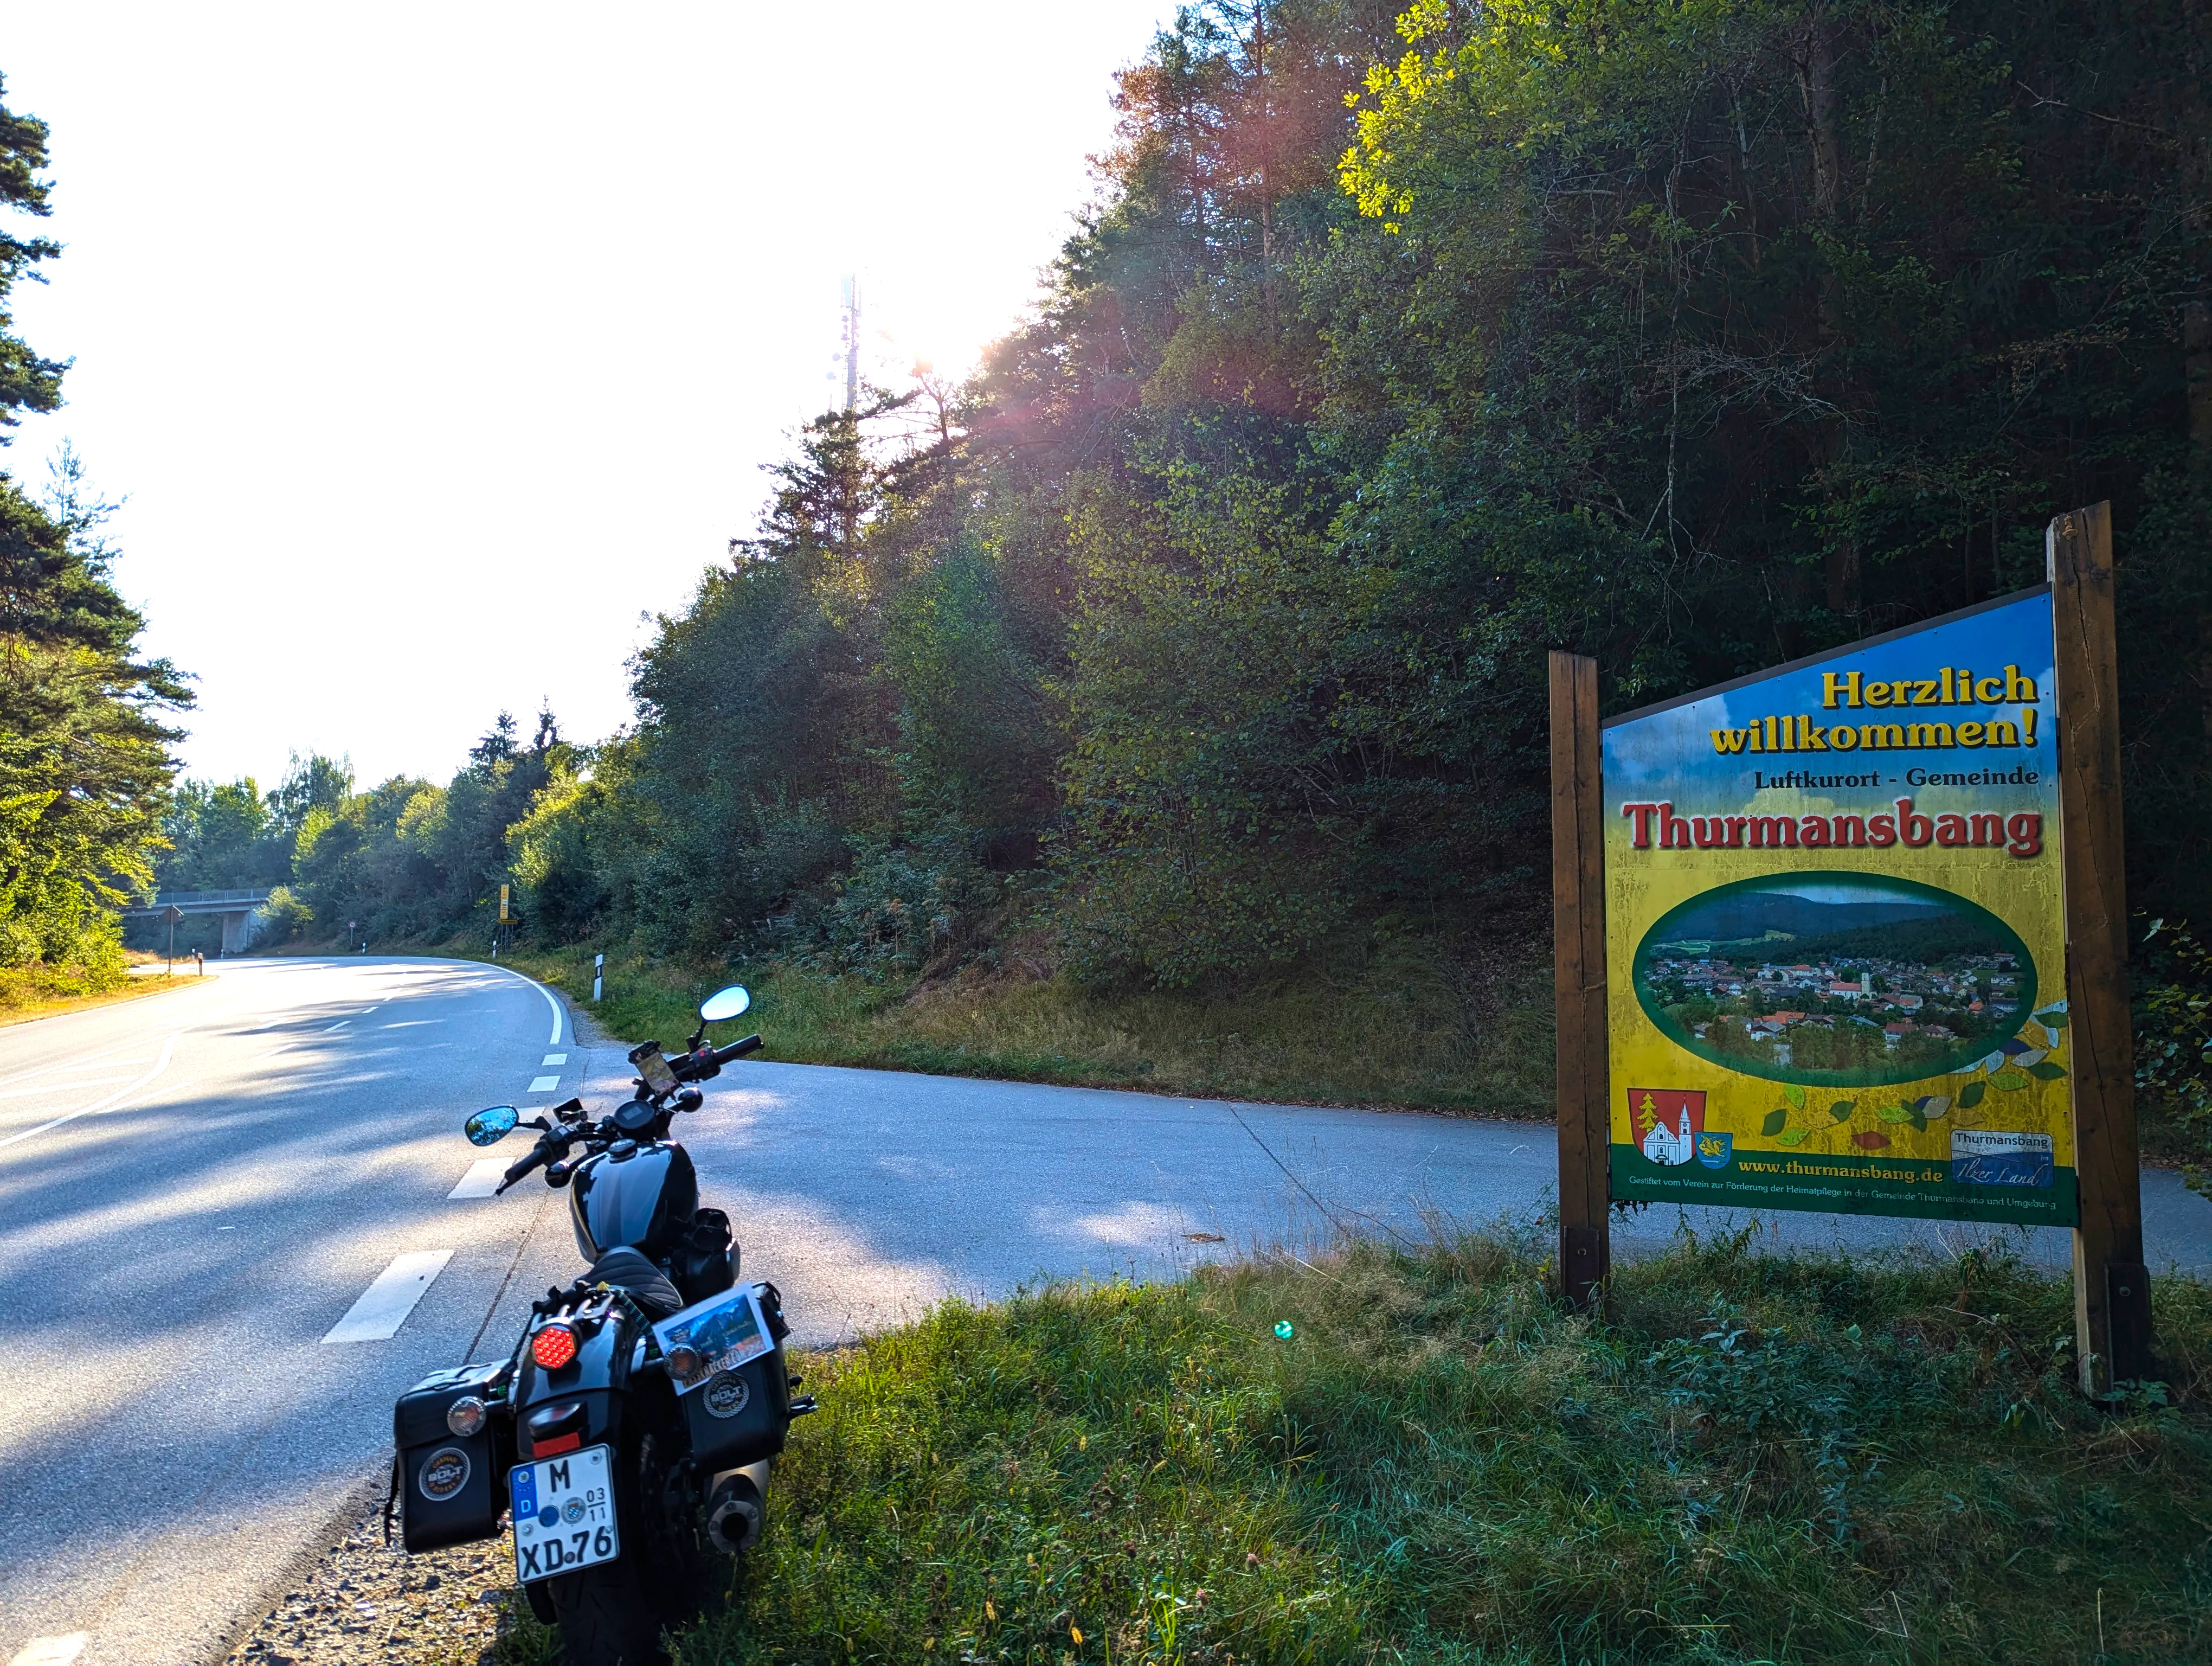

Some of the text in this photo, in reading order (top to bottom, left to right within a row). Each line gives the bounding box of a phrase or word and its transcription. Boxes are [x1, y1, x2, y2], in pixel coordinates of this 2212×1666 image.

[1822, 664, 2039, 709] Herzlich
[1710, 708, 2039, 755] willkommen!
[1754, 769, 1880, 789] Luftkurort
[1906, 766, 2039, 786] Gemeinde
[1623, 797, 2041, 857] Thurmansbang
[1954, 1133, 2048, 1149] Thurmansbang
[1738, 1161, 1944, 1183] www.thurmansbang.de
[1957, 1158, 2049, 1187] Ilzer Land
[1629, 1176, 1661, 1186] Gestiftet
[1683, 1179, 1709, 1188] Verein
[1726, 1181, 1769, 1193] Förderung
[1770, 1184, 1784, 1193] der
[1786, 1186, 1842, 1197] Heimatpflege
[1855, 1189, 1869, 1197] der
[1871, 1190, 1915, 1201] Gemeinde
[1986, 1197, 2004, 1206] und
[2007, 1199, 2056, 1210] Umgebung
[710, 1386, 742, 1402] BOLT
[428, 1466, 463, 1482] BOLT
[549, 1459, 570, 1492] M
[520, 1500, 531, 1513] D
[586, 1488, 605, 1502] 03
[590, 1507, 606, 1522] 11
[521, 1526, 612, 1578] XD 76
